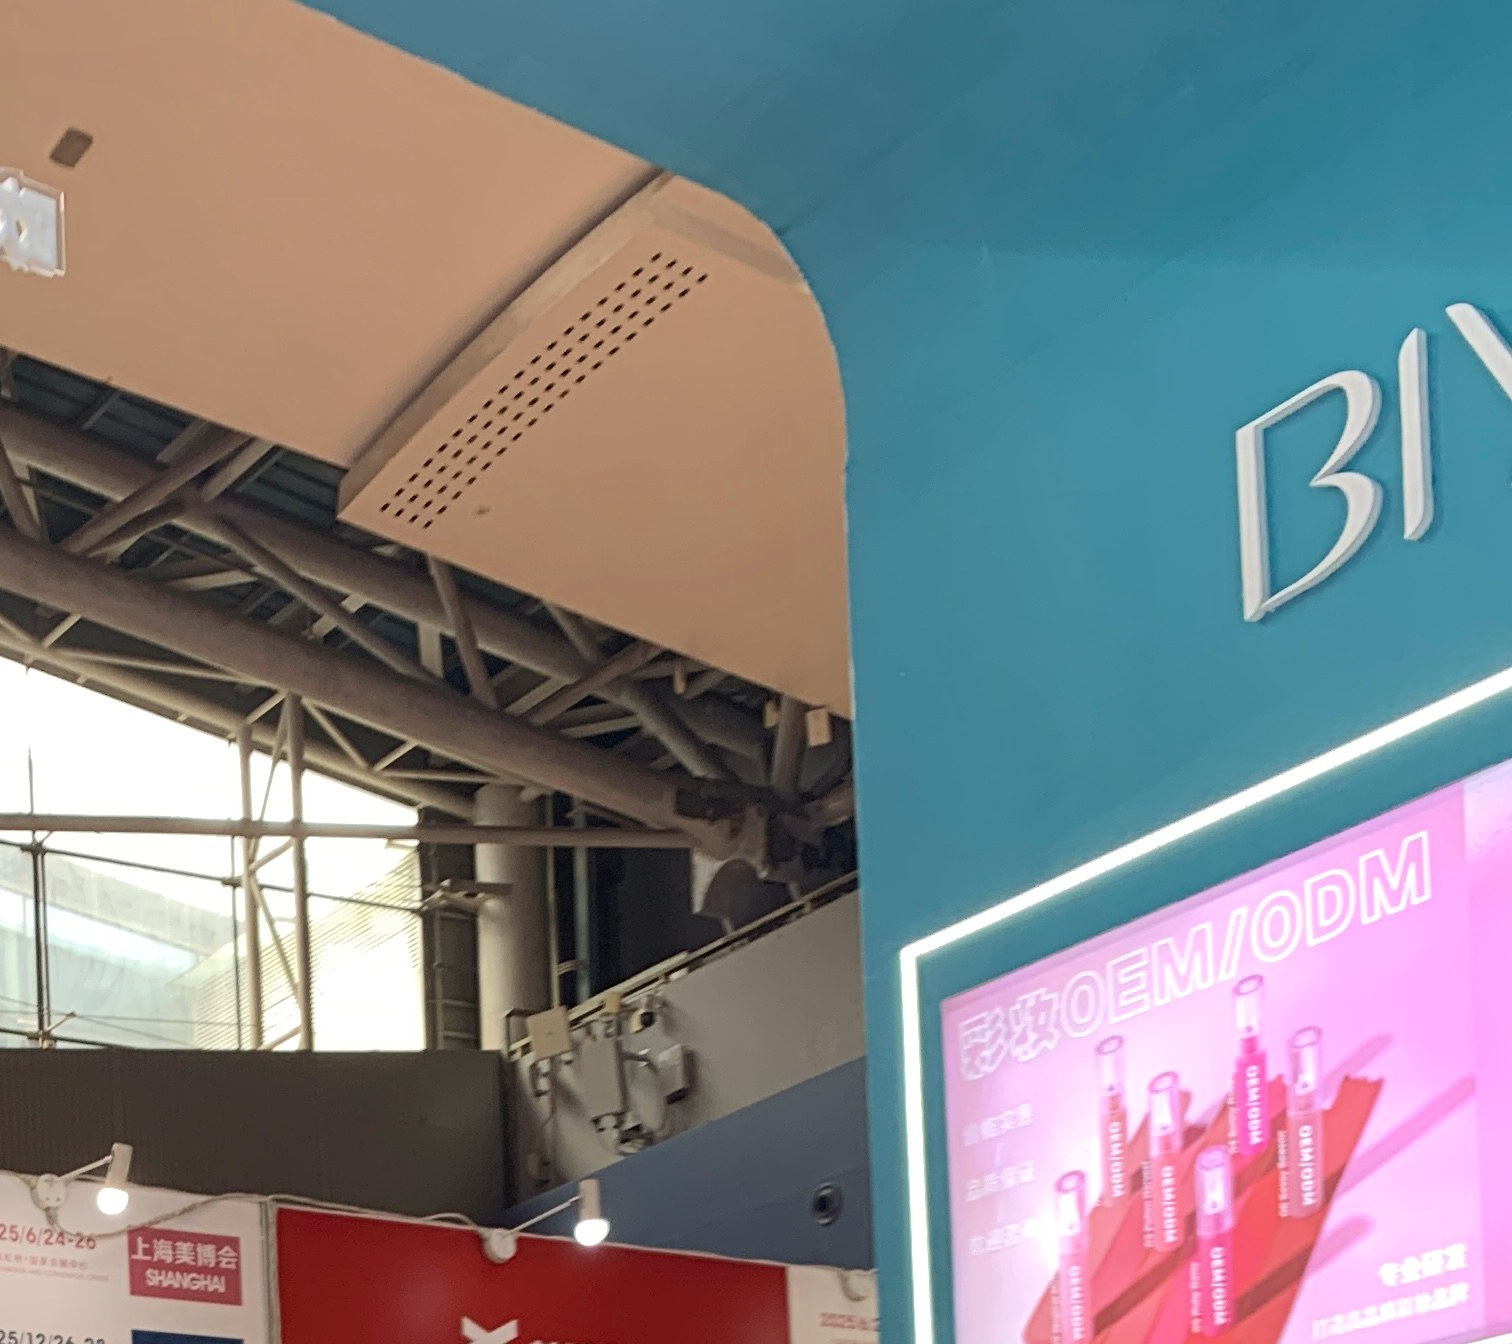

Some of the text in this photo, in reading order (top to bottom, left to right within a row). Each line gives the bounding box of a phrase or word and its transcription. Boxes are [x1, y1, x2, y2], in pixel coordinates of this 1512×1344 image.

[131, 1237, 239, 1269] 上海美博会
[145, 1269, 226, 1292] SHANGHAI
